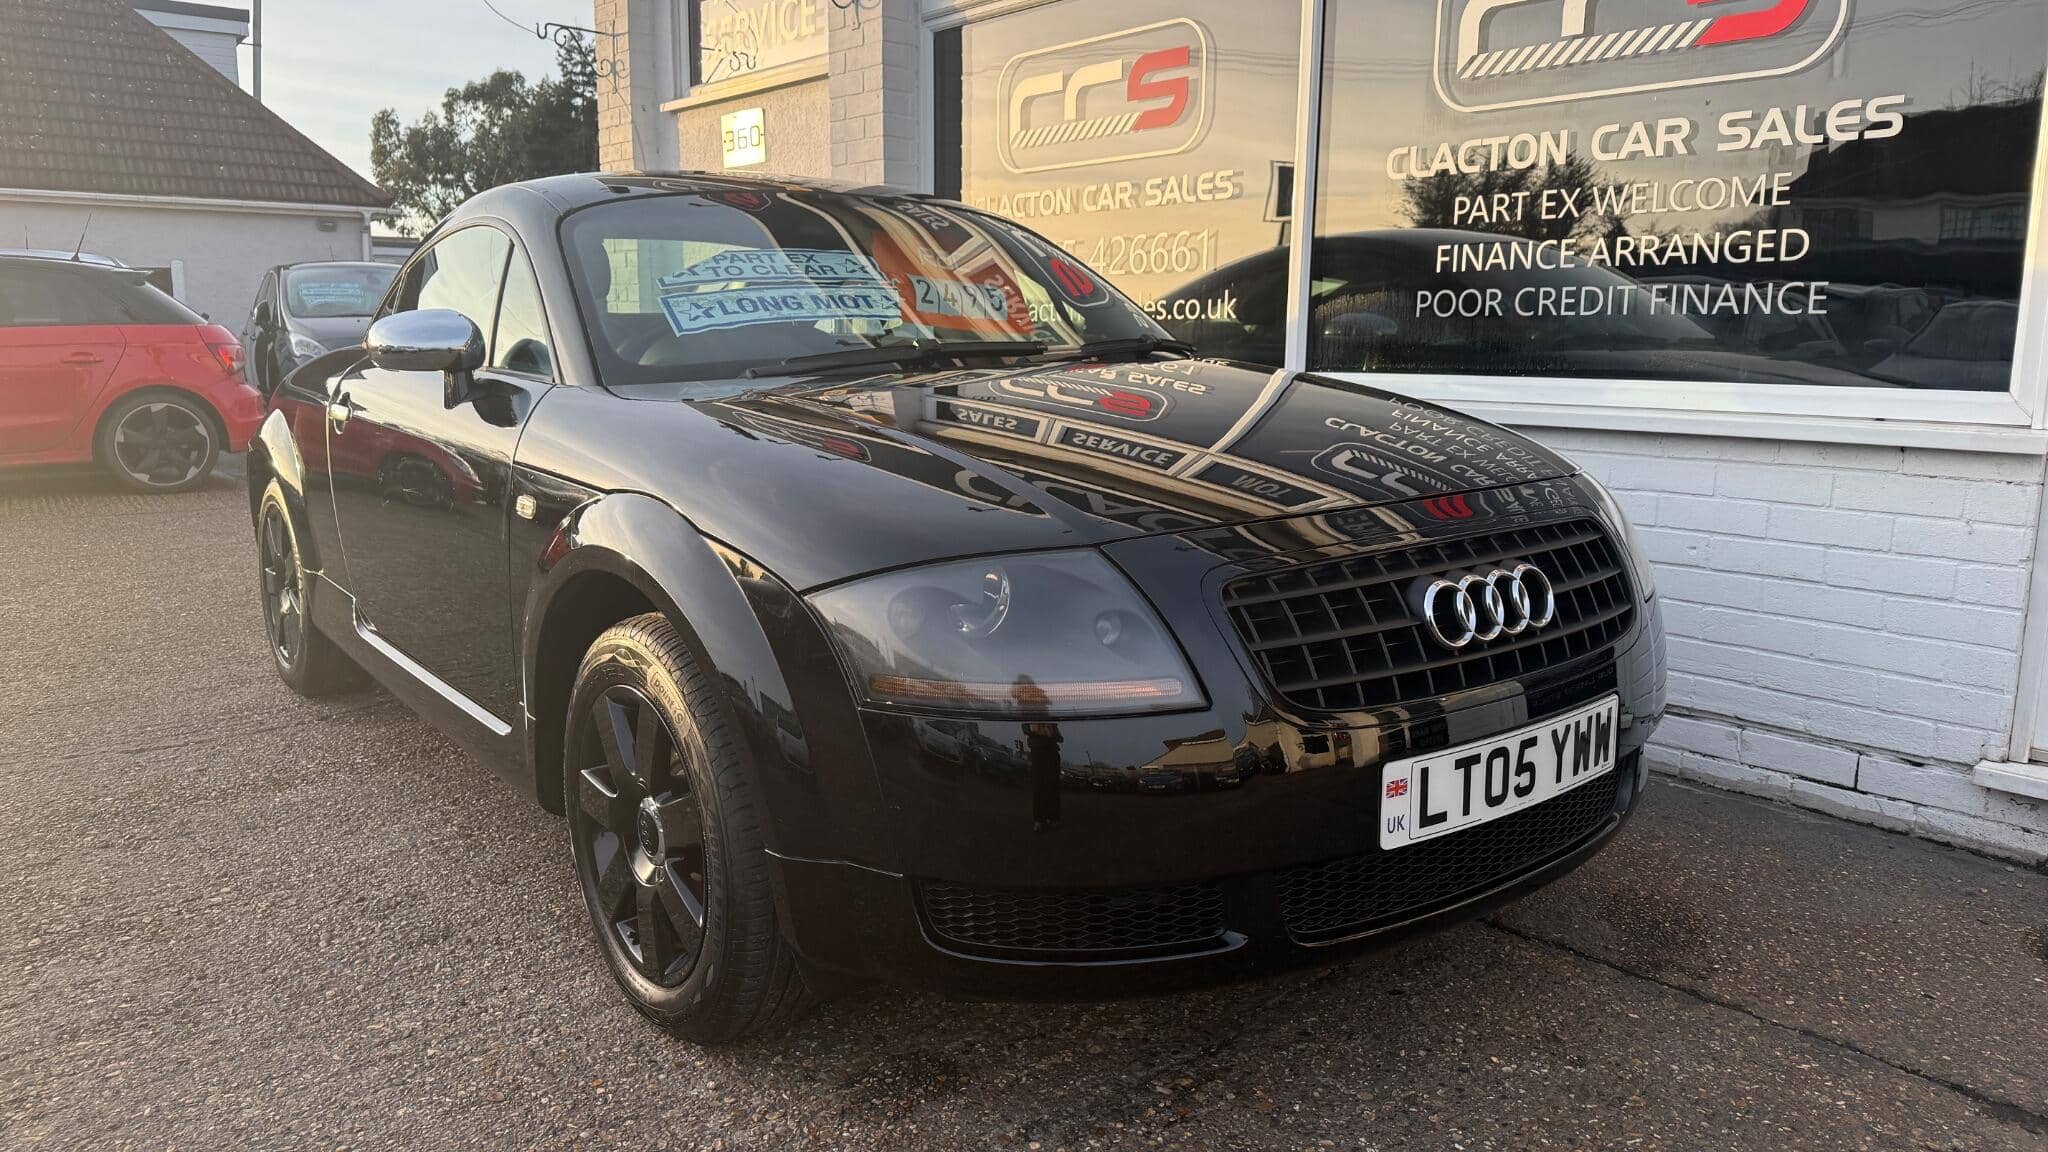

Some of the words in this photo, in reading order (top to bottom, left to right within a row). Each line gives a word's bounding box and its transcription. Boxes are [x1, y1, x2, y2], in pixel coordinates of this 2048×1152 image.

[725, 124, 761, 152] 360
[1387, 130, 1568, 181] CLACTON
[1590, 117, 1691, 161] CAR
[1717, 94, 1905, 151] SALES
[1082, 181, 1133, 213] CAR
[1144, 169, 1235, 207] SALES
[1453, 191, 1530, 225] PART
[1541, 187, 1582, 220] EX
[1593, 172, 1793, 216] WELCOME
[712, 252, 777, 265] PART
[784, 253, 820, 265] EX
[1088, 227, 1210, 275] 426661
[1435, 238, 1577, 273] FINANCE
[1587, 228, 1810, 268] ARRANGED
[704, 263, 745, 277] TO
[751, 264, 836, 277] CLEAR
[716, 294, 804, 316] LONG
[812, 294, 875, 312] MOT
[915, 279, 1003, 313] 2495
[1415, 288, 1503, 318] POOR
[1514, 284, 1637, 316] CREDIT
[1649, 281, 1829, 316] FINANCE
[1418, 735, 1538, 829] LT05
[1551, 706, 1613, 784] YWW
[1387, 814, 1405, 834] UK
